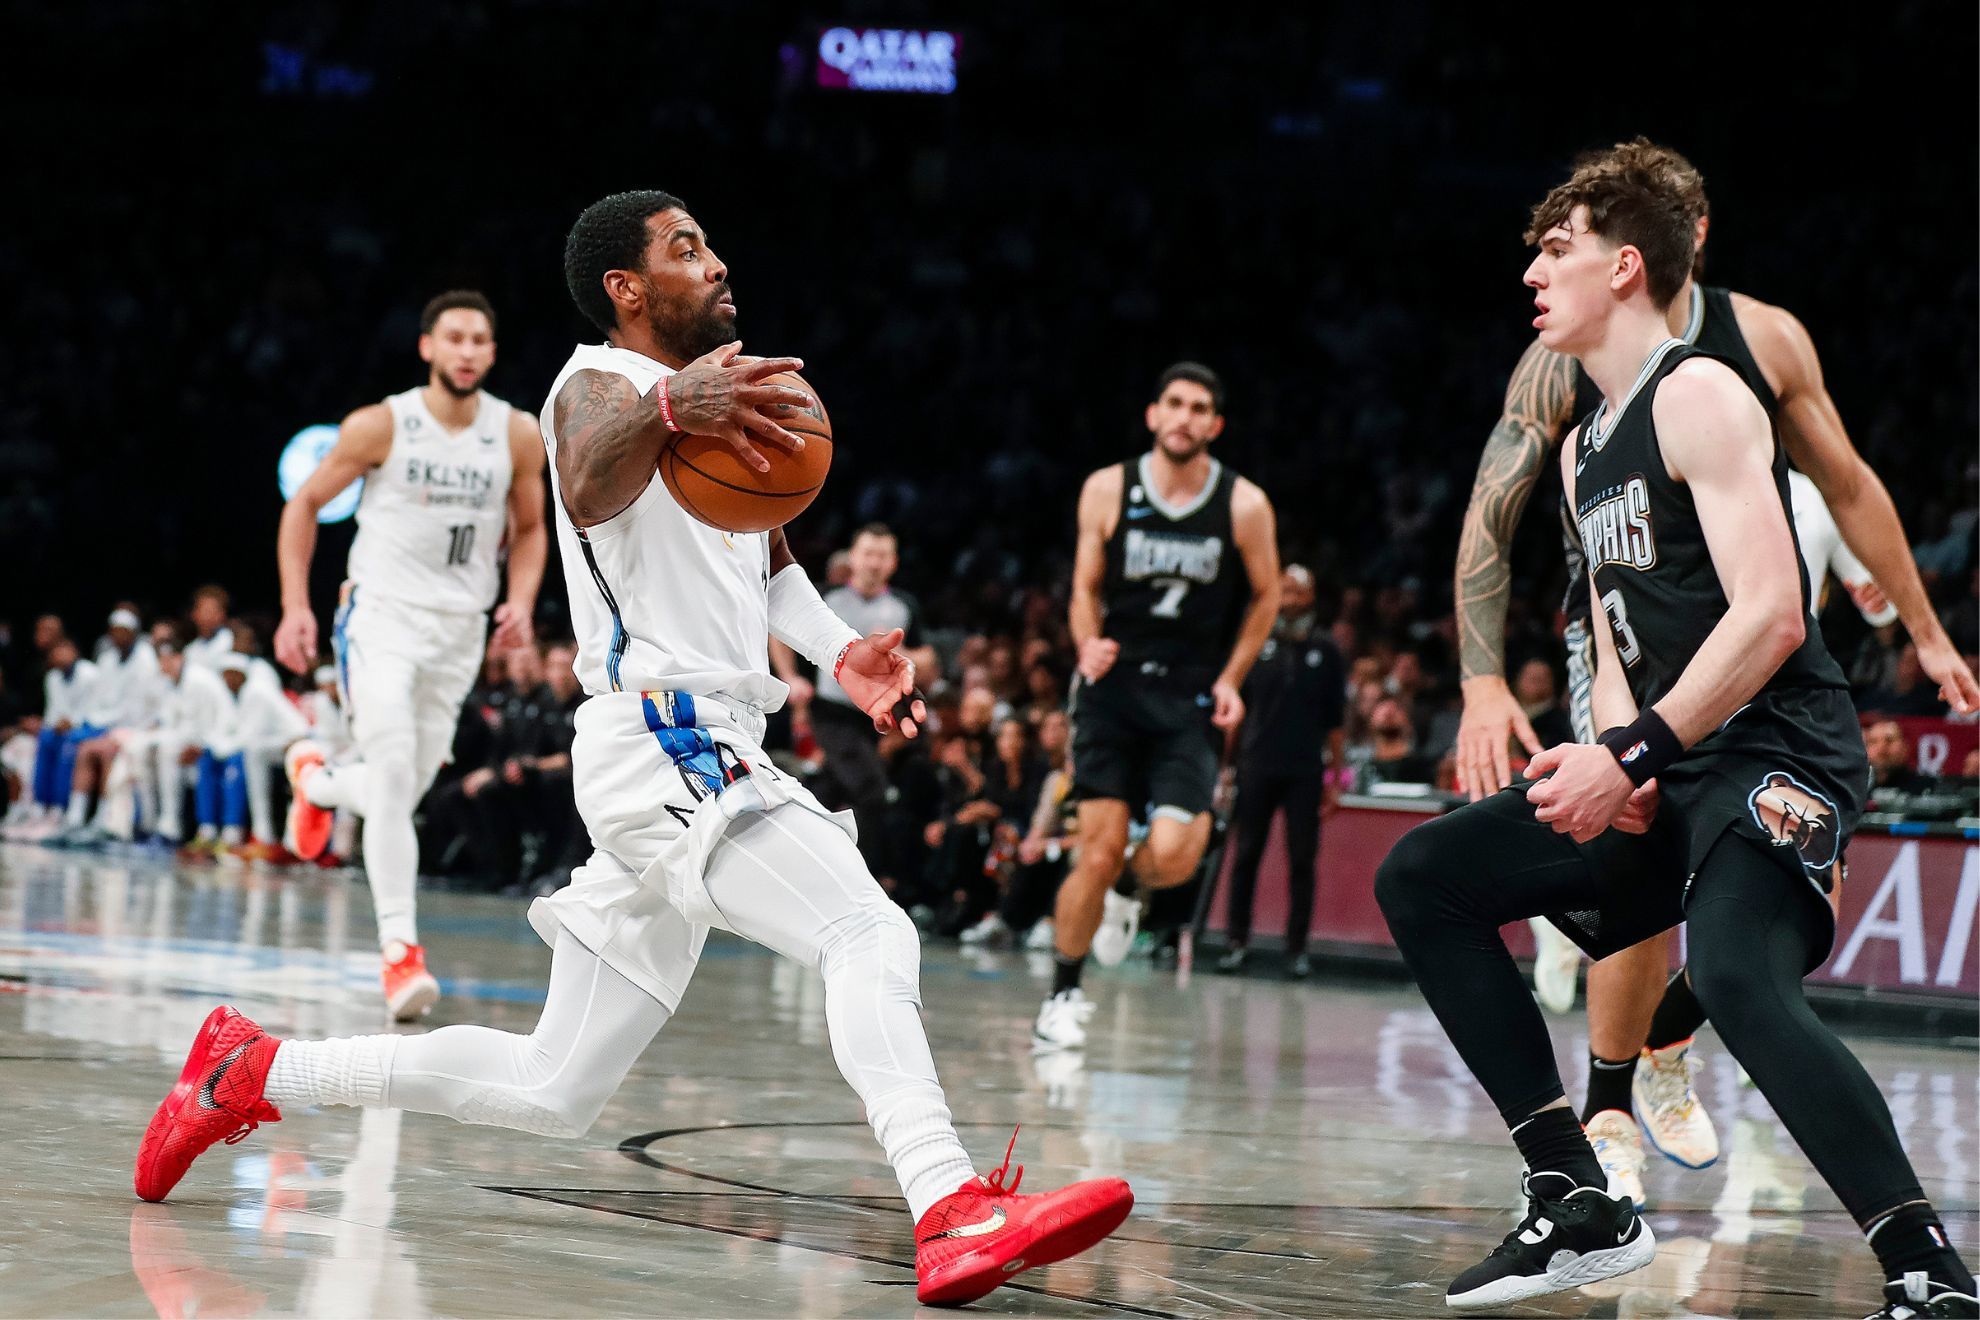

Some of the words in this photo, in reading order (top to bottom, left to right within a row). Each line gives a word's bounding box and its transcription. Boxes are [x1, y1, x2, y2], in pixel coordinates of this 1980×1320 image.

[819, 27, 956, 73] QATAR
[406, 458, 493, 490] BKLYN
[447, 525, 475, 565] 10
[1578, 478, 1656, 577] EMPHIS
[1151, 578, 1188, 616] 7
[1601, 587, 1642, 668] 3
